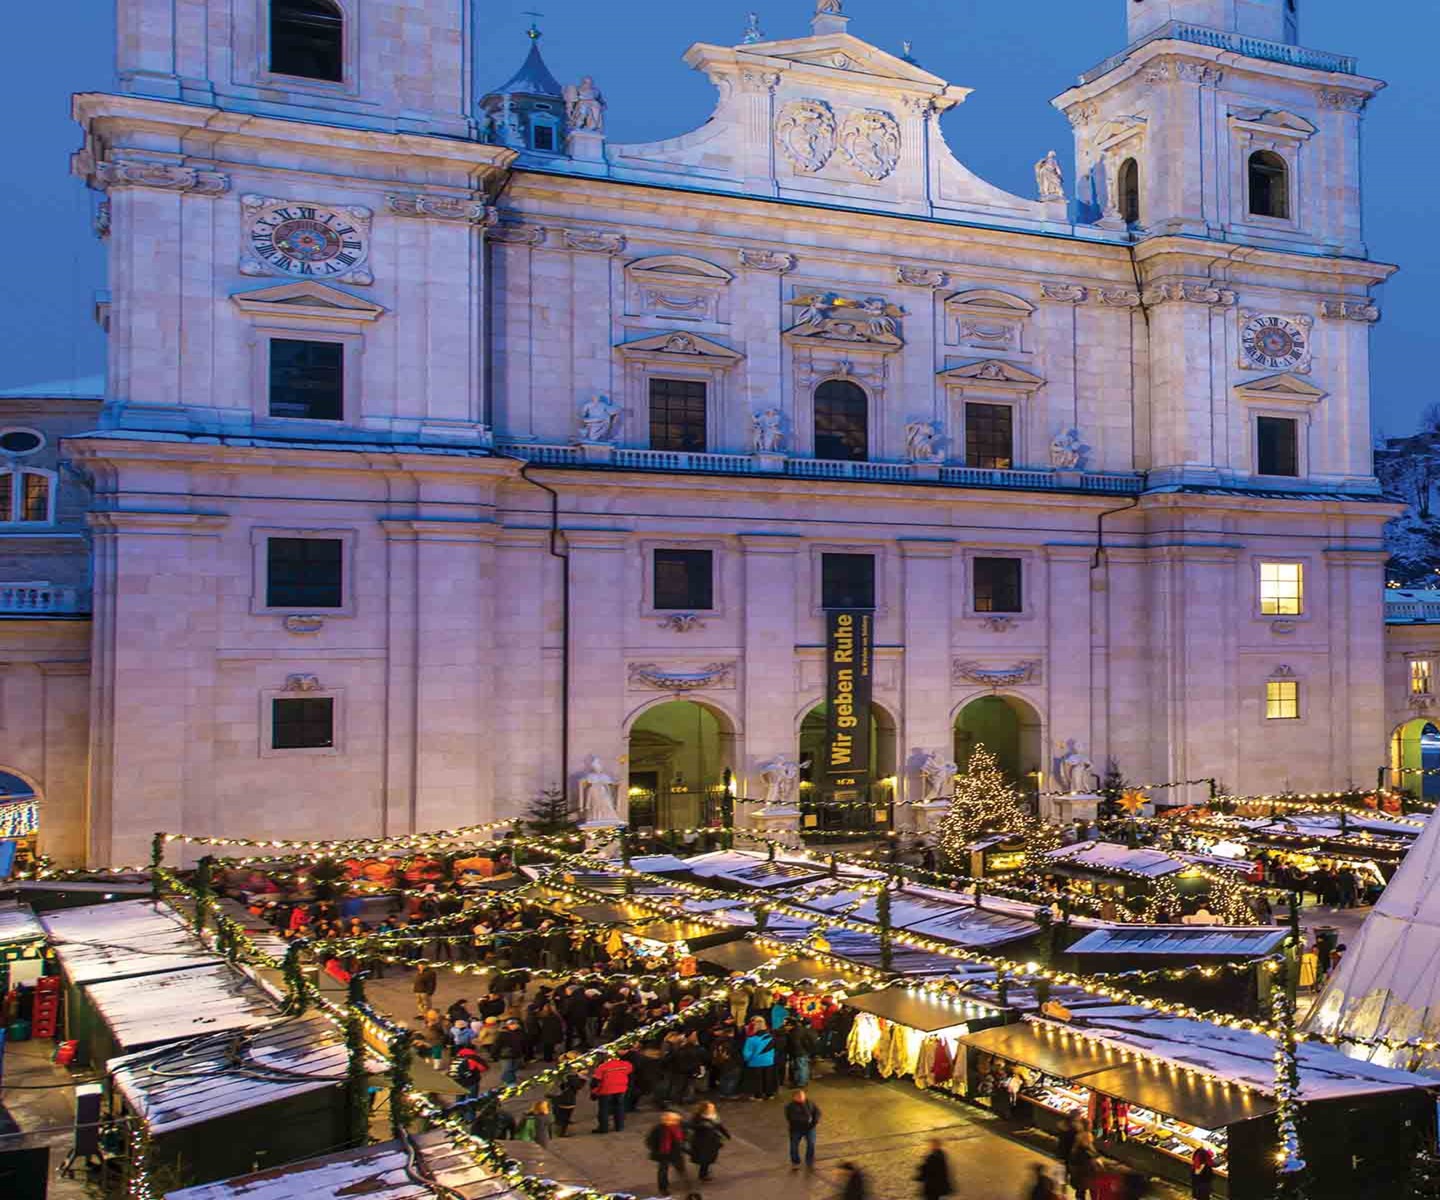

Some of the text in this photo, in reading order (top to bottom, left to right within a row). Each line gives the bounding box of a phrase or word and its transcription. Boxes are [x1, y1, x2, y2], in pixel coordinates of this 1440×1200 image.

[831, 614, 857, 765] Wir geben Ruhe
